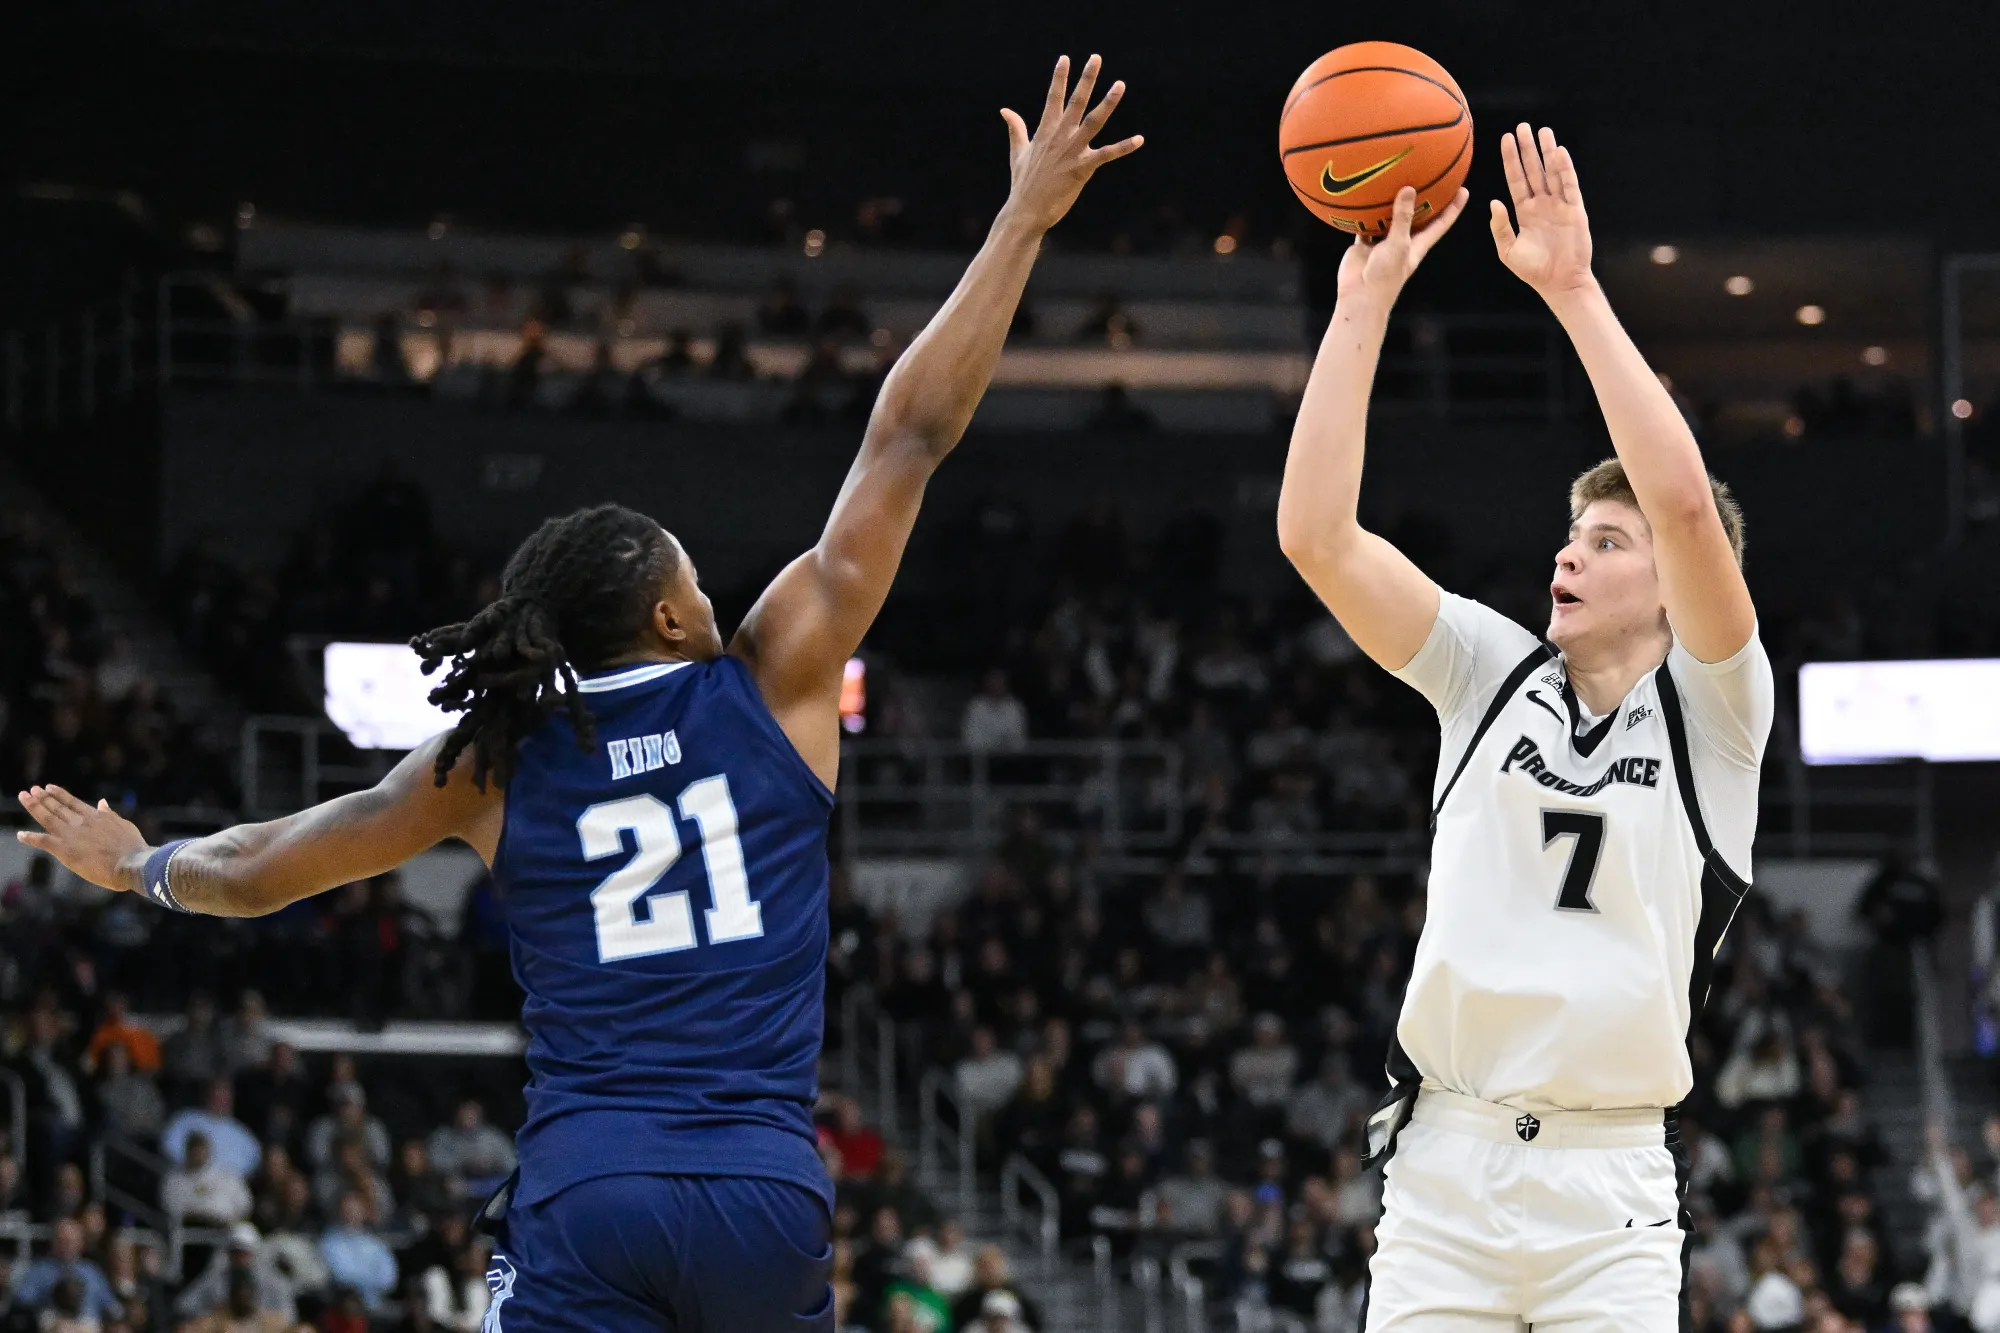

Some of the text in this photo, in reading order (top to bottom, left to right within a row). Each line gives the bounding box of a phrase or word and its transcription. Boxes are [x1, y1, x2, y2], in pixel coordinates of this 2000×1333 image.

[1627, 709, 1653, 727] EAST
[1629, 704, 1645, 720] BIG
[607, 729, 682, 780] KING
[576, 773, 765, 963] 21
[1539, 807, 1608, 914] 7
